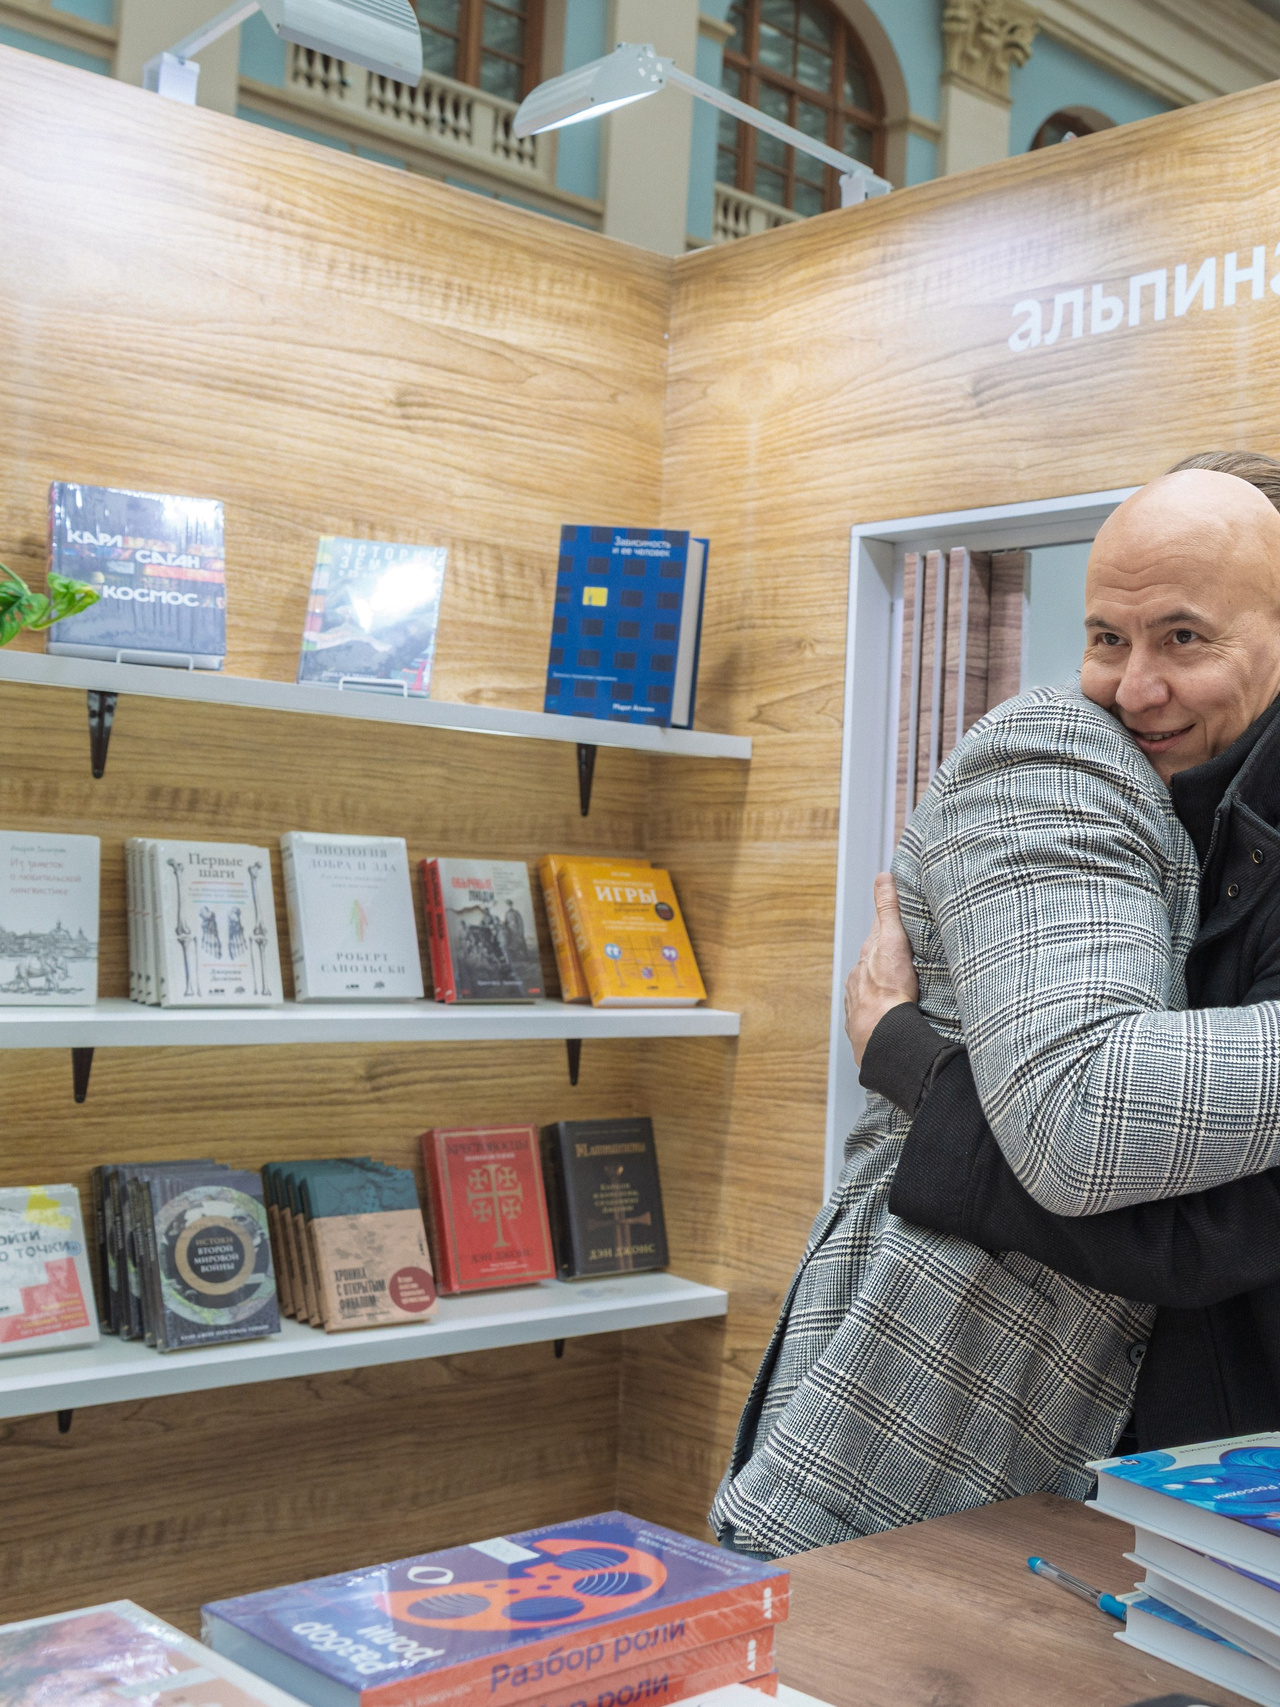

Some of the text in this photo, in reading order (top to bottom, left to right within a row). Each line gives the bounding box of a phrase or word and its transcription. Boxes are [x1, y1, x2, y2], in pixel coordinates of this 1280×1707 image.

[66, 530, 123, 548] КАРЛ
[614, 535, 672, 549] Зависимость
[135, 549, 200, 569] САГАН
[633, 547, 671, 558] человек
[102, 584, 200, 607] КОСМОС
[314, 845, 388, 859] БИОЛОГИЯ
[188, 852, 244, 868] Первые
[199, 868, 235, 879] шаги
[594, 885, 658, 904] ИГРЫ
[336, 952, 389, 961] РОБЕРТ
[321, 964, 406, 974] САПОЛЬСКИ
[195, 1236, 234, 1247] ИСТОКИ
[198, 1244, 234, 1255] ВТОРОЙ
[194, 1252, 240, 1265] МИРОВОЙ
[200, 1262, 235, 1273] ВОЙНЫ
[1213, 1484, 1279, 1499] Россохин
[292, 1621, 400, 1675] Разбор
[356, 1624, 446, 1668] роли
[491, 1618, 685, 1694] Разбор роли
[598, 1673, 669, 1707] роли
